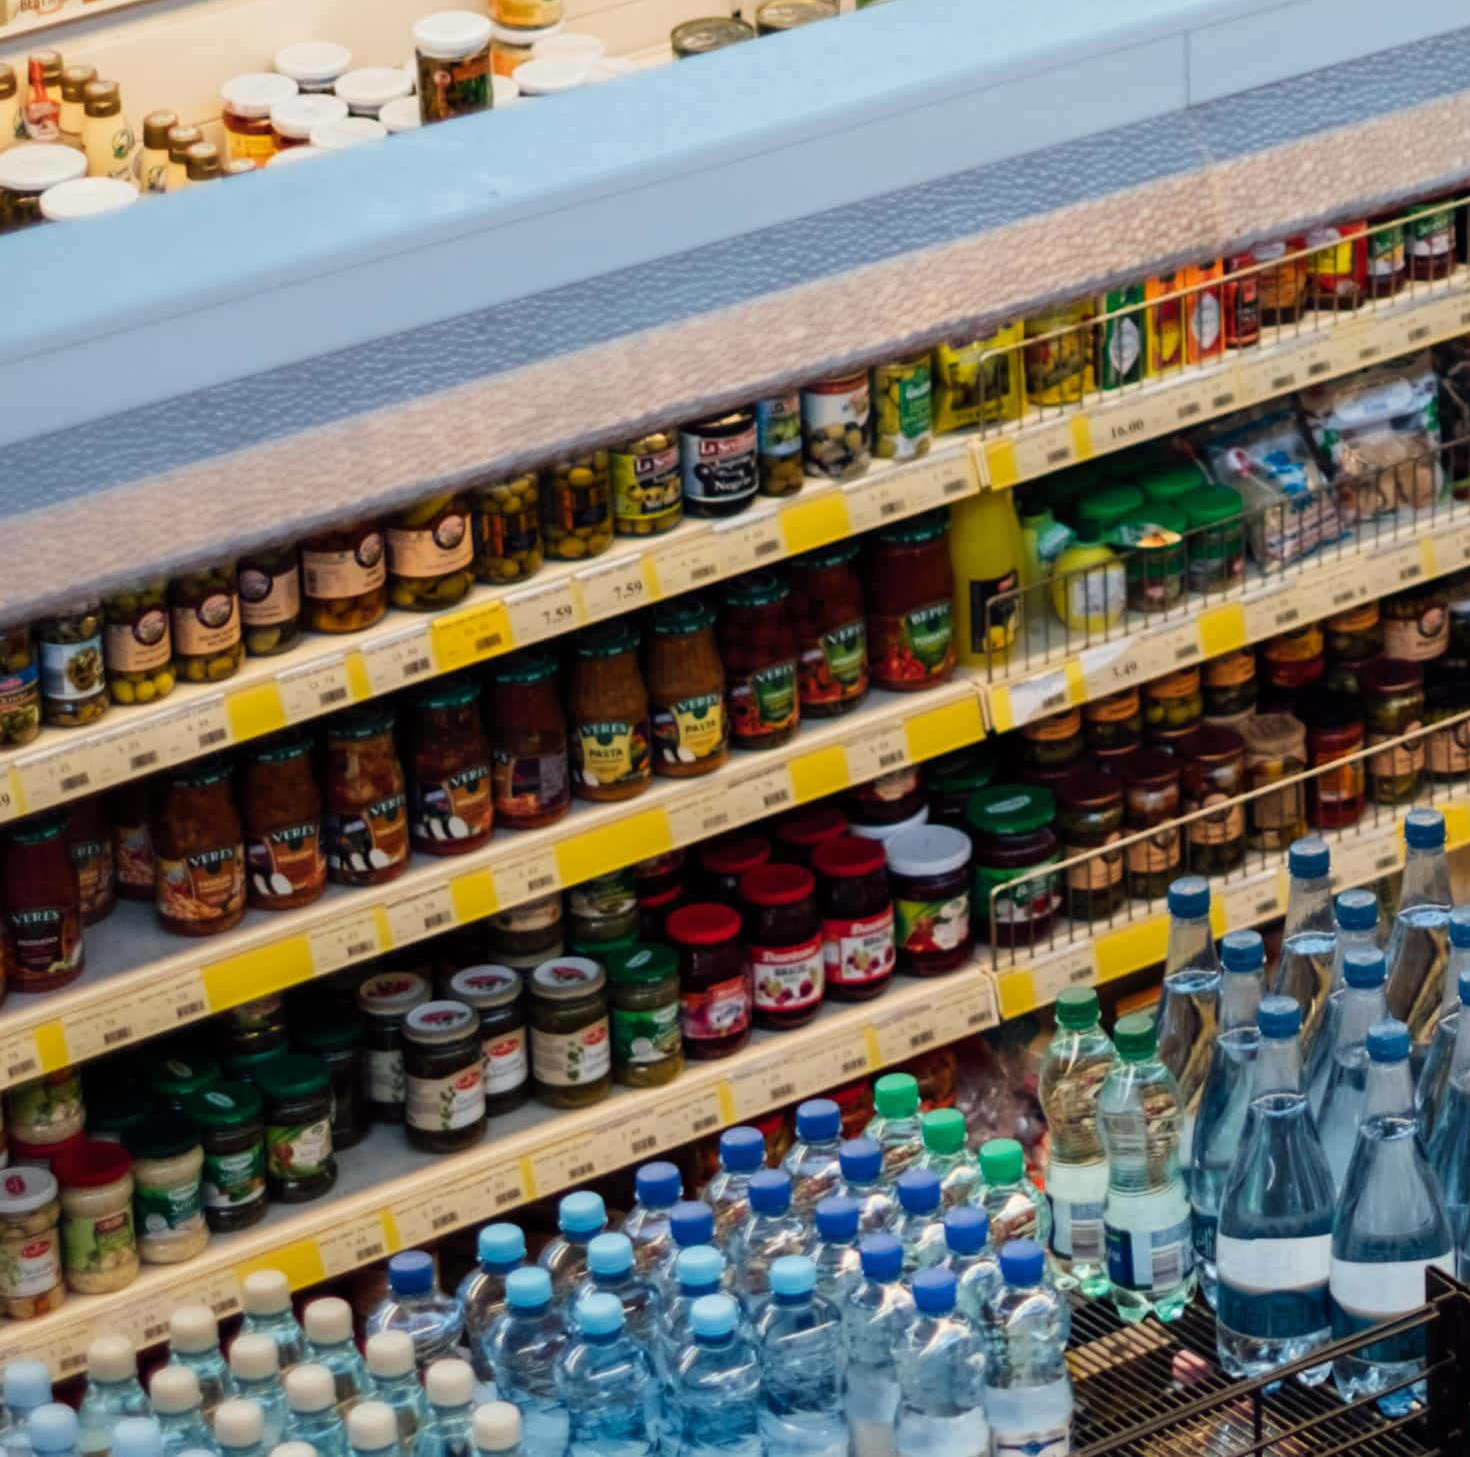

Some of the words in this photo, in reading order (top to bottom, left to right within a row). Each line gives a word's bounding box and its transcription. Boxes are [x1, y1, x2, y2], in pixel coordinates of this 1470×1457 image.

[613, 580, 643, 601] 7.59
[542, 605, 573, 626] 7.59
[581, 722, 628, 736] VERES
[588, 746, 624, 758] PASTA
[271, 823, 315, 843] VERES
[188, 848, 234, 867] VERES
[12, 910, 60, 924] VERES
